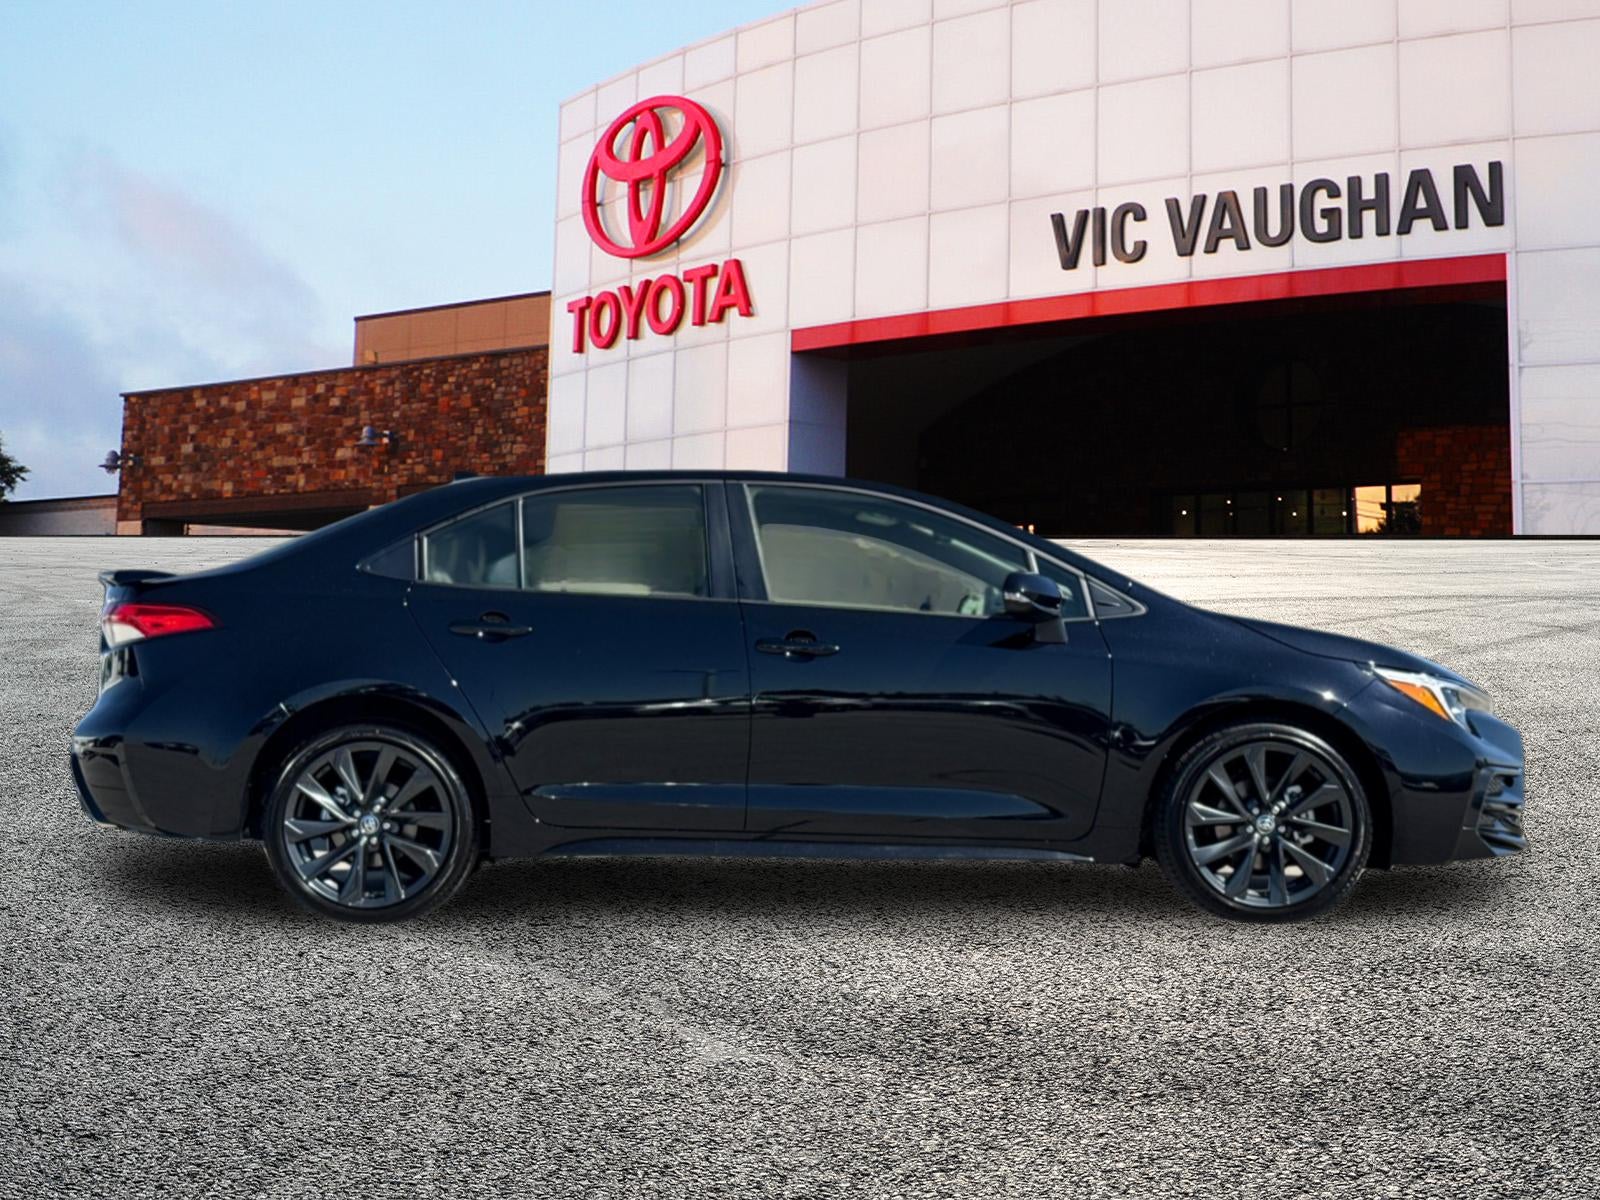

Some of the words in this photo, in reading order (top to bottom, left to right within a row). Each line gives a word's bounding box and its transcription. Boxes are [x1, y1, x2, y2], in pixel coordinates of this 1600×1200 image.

[1051, 202, 1147, 270] VIC
[1165, 160, 1504, 257] VAUGHAN
[568, 258, 753, 354] TOYOTA
